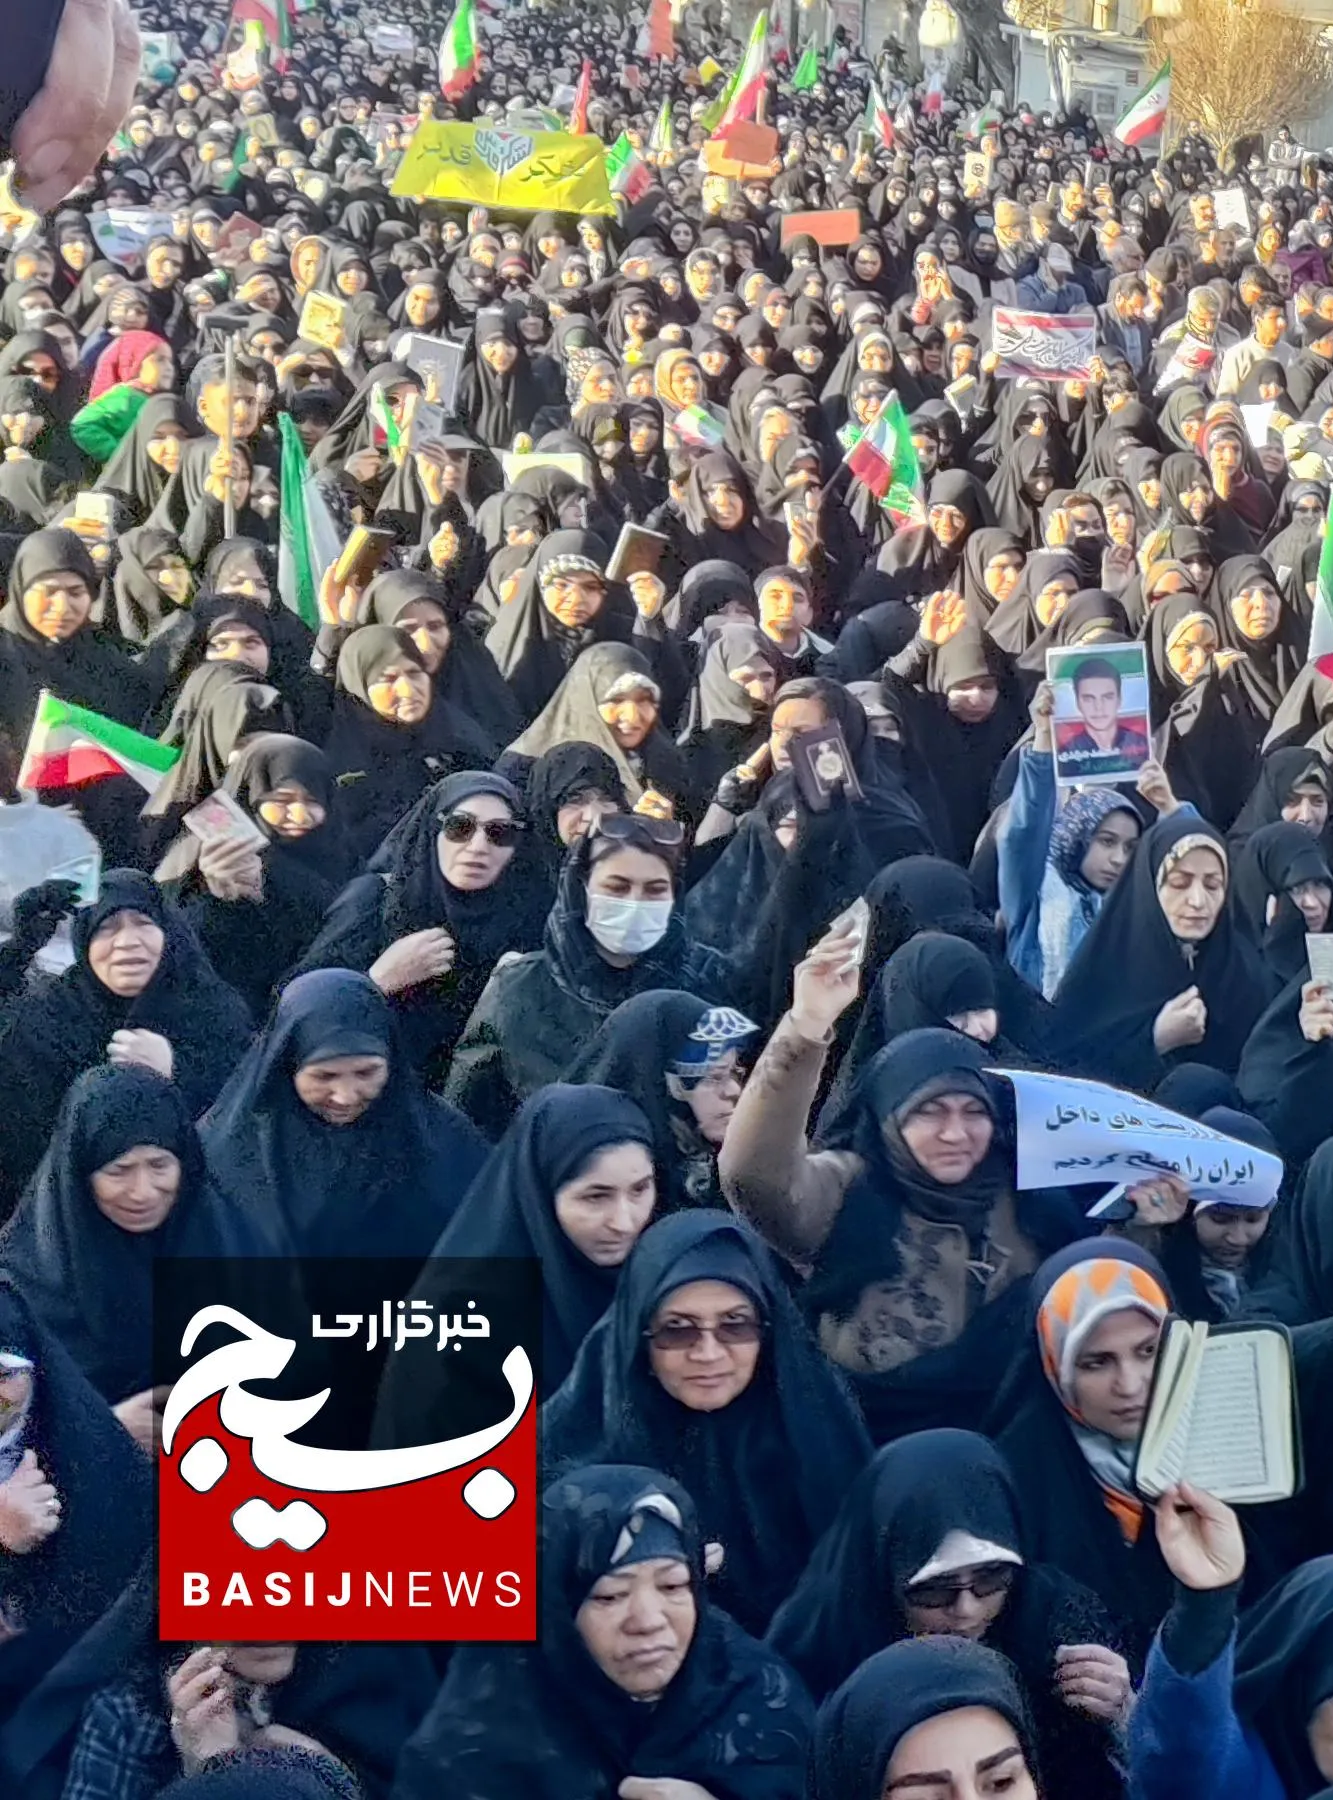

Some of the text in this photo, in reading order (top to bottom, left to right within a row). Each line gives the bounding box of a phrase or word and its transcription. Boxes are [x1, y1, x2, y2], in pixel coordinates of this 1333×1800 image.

[1046, 1104, 1100, 1131] داخل
[1108, 1111, 1143, 1129] های
[1186, 1155, 1203, 1182] را
[1208, 1158, 1254, 1186] ایران
